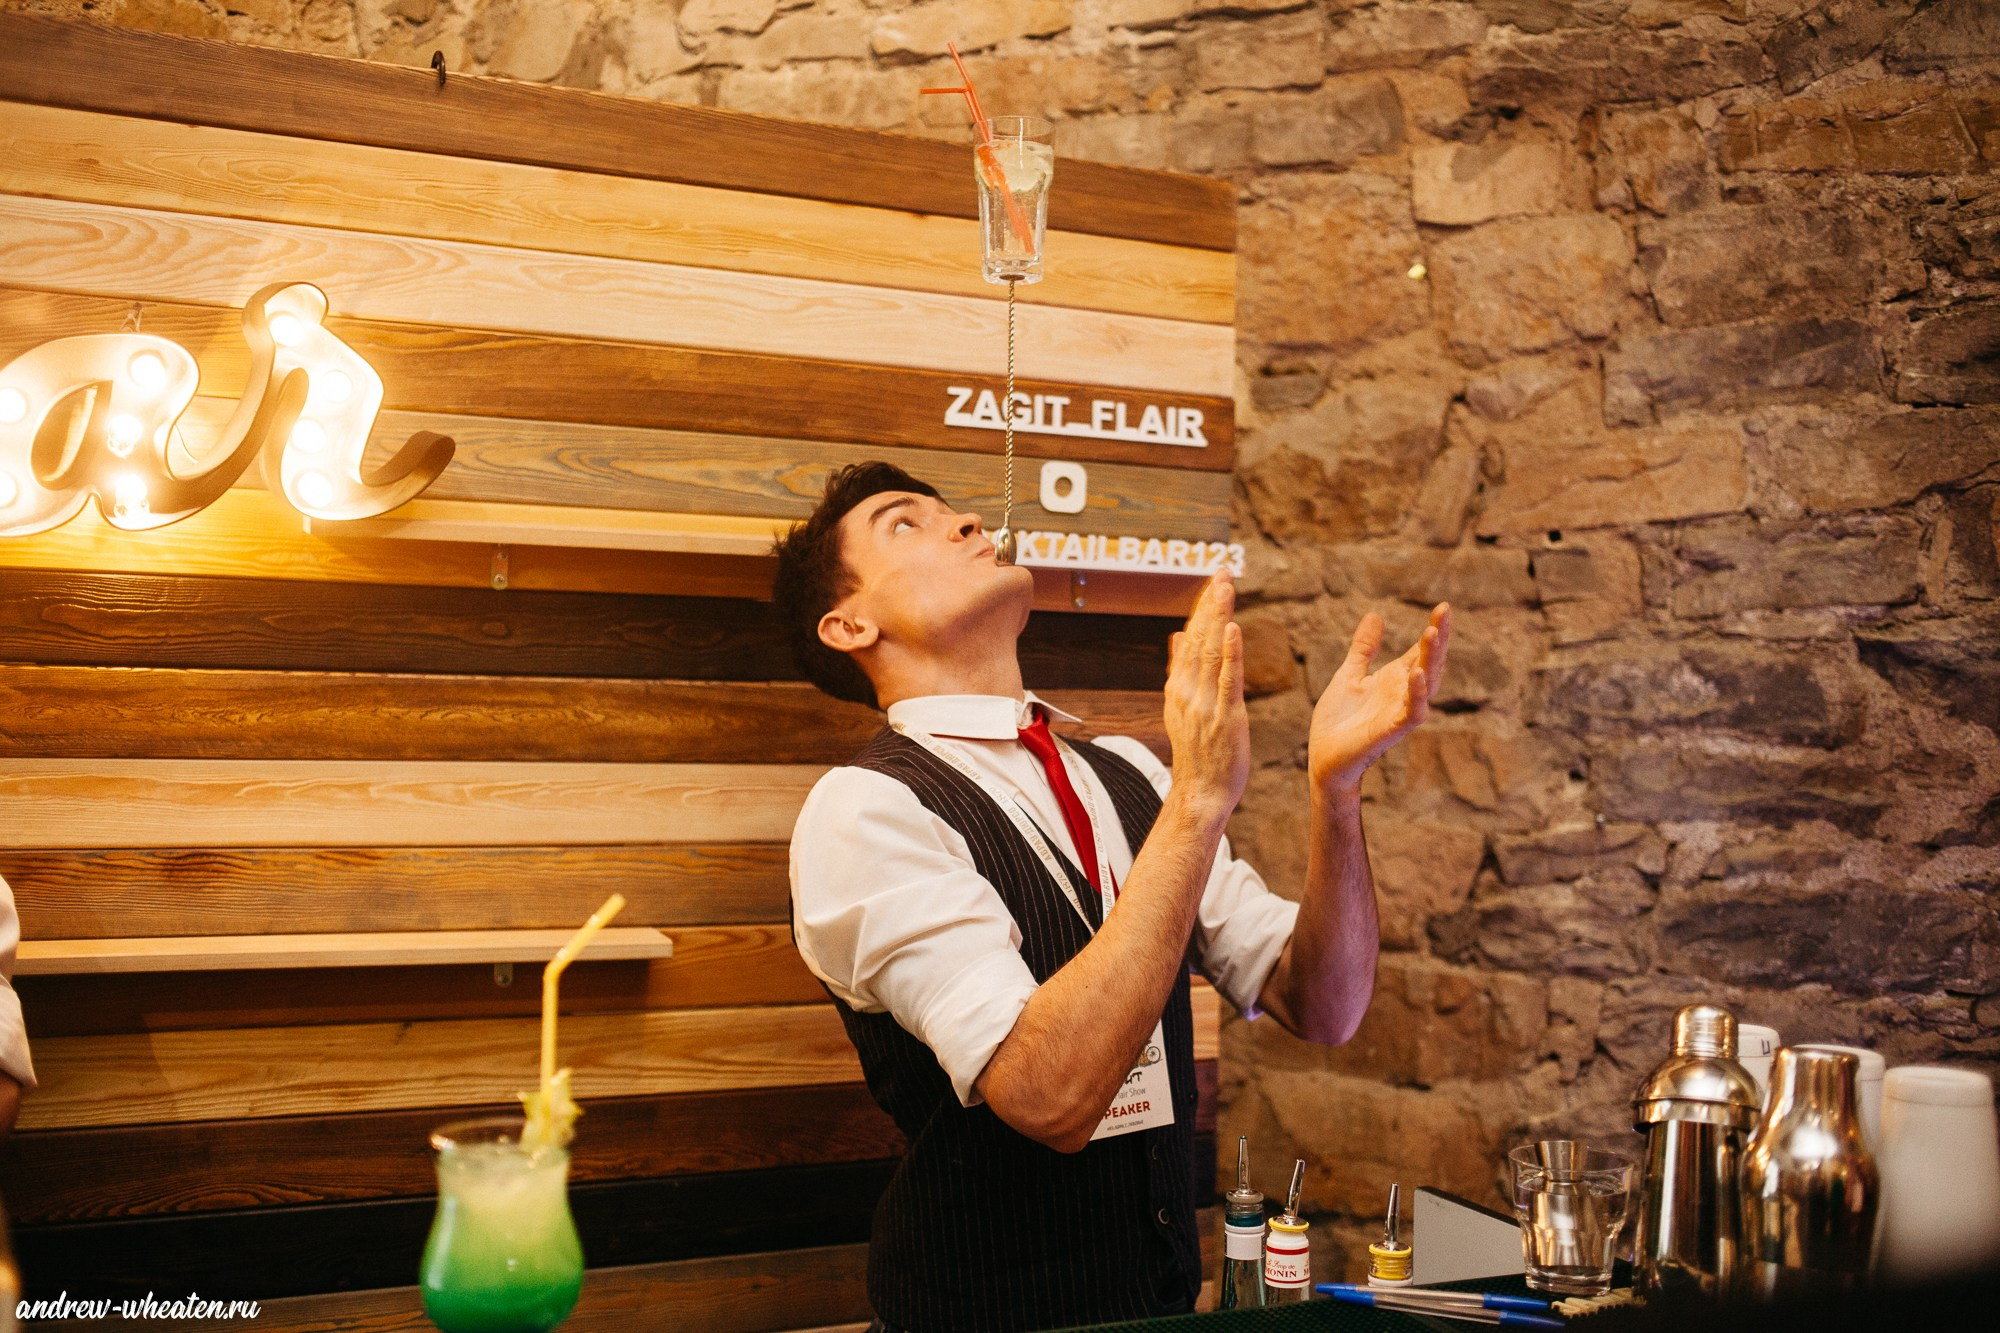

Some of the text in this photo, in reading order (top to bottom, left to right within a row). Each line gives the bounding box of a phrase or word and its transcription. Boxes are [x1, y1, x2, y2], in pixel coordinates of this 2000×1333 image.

[944, 386, 1208, 448] ZAGIT_FLAIR
[1129, 1086, 1146, 1098] Show
[1103, 1101, 1151, 1120] PEAKER
